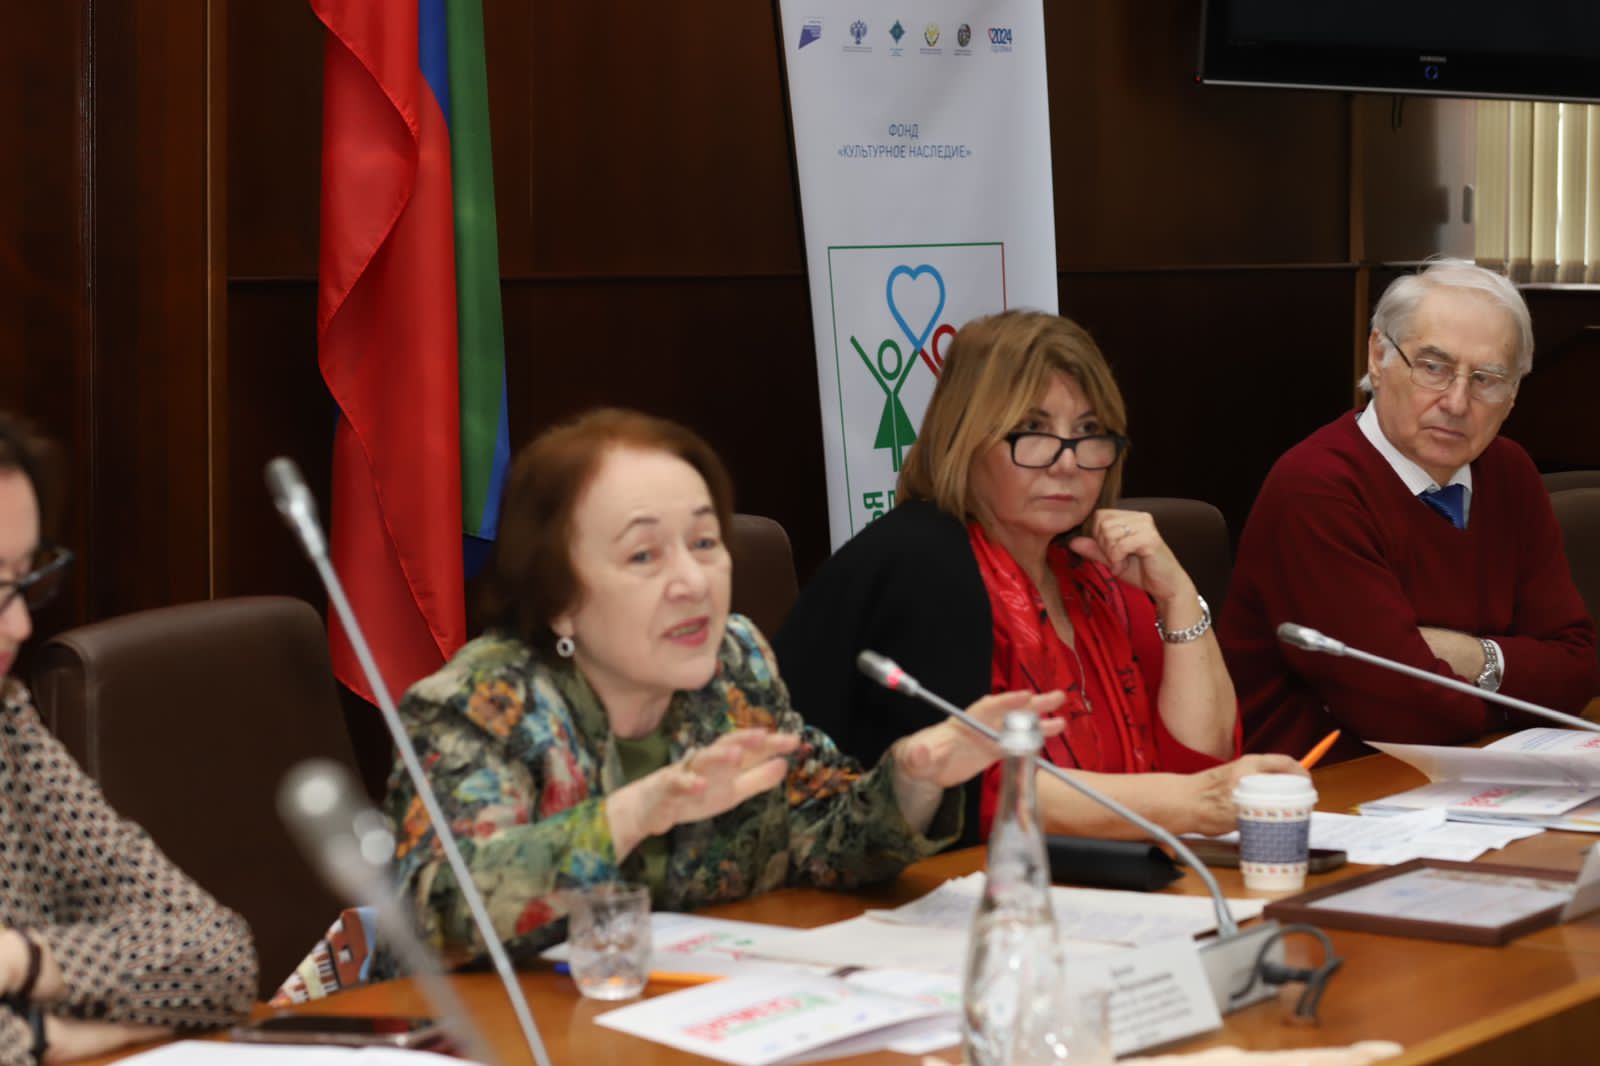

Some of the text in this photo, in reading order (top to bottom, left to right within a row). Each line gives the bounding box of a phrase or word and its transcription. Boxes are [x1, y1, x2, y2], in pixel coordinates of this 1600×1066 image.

[991, 27, 1012, 44] 2024
[888, 123, 919, 139] ФОНД
[838, 144, 972, 159] «КУЛЬТУРНОЕ НАСЛЕДИЕ»
